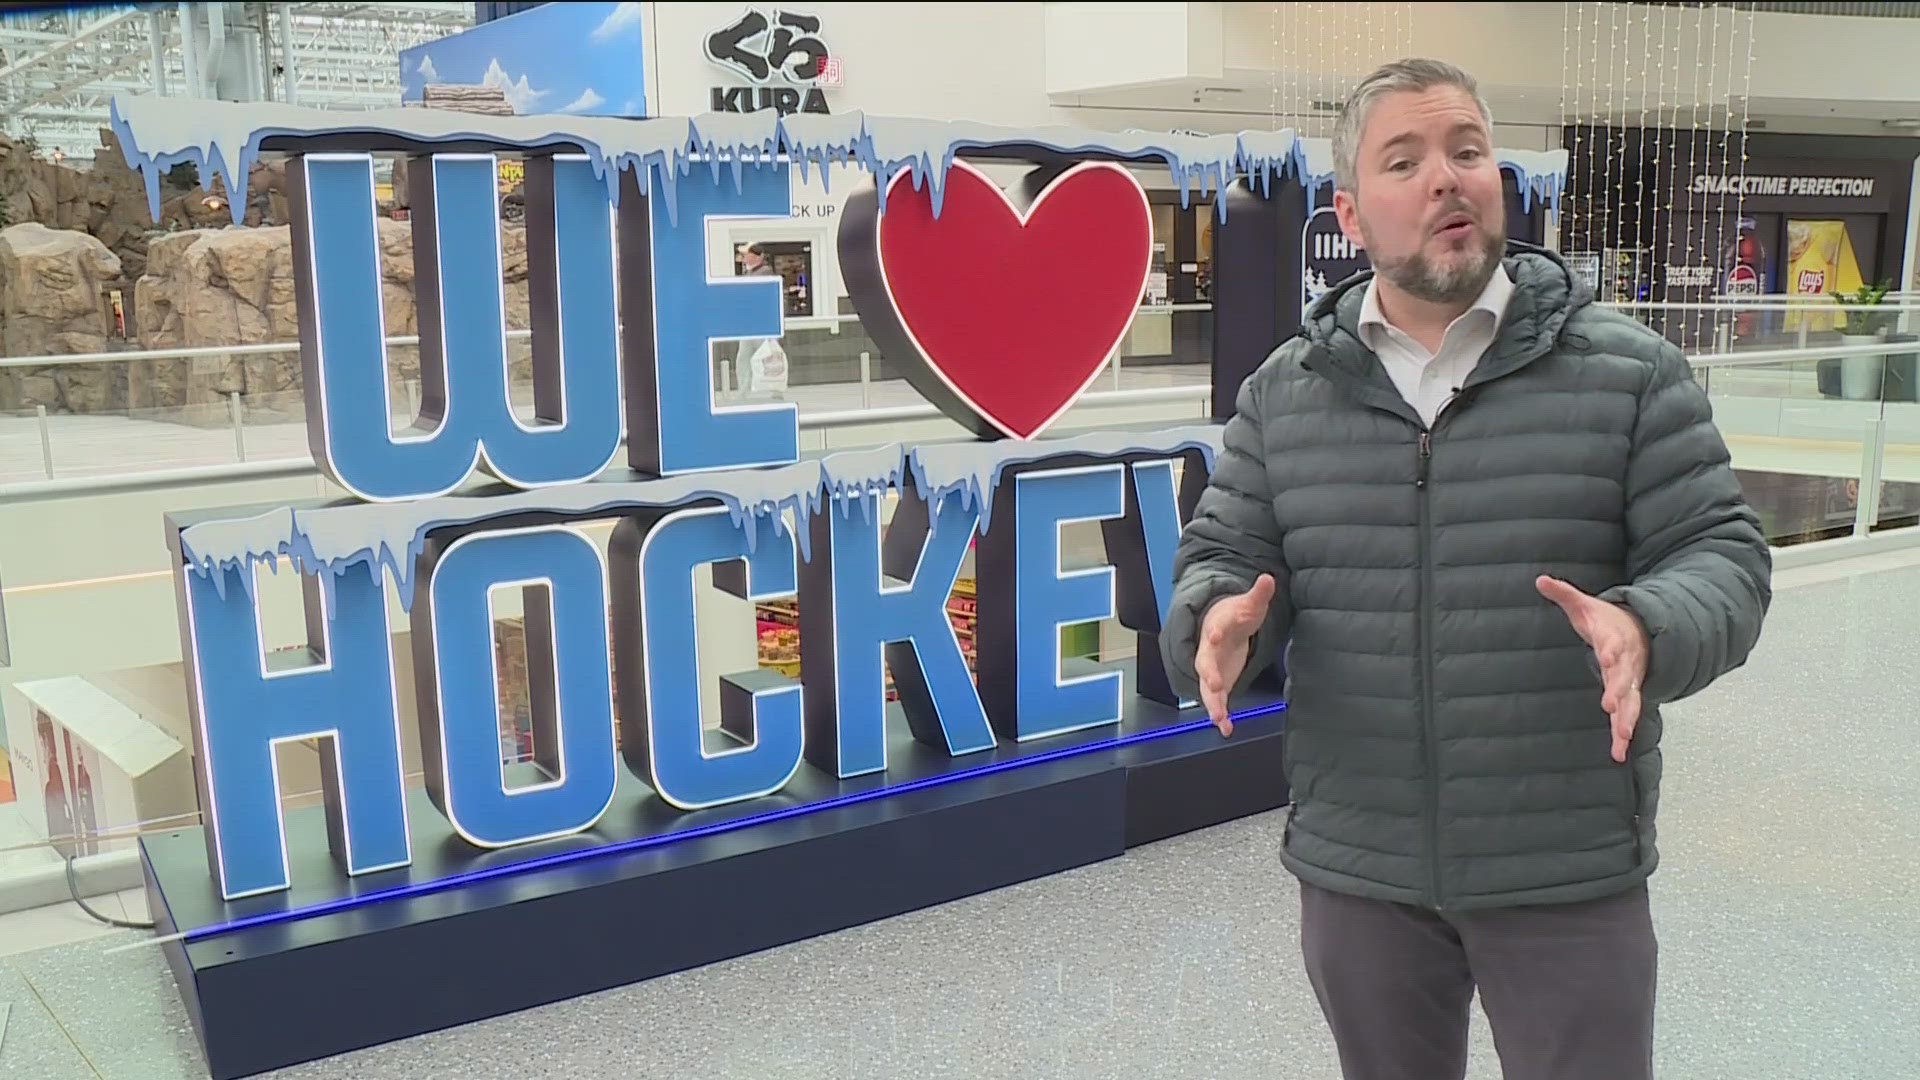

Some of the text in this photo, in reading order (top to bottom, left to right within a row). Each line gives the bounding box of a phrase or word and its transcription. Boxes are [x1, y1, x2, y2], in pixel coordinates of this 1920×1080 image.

[710, 87, 830, 116] KURA
[1693, 175, 1874, 196] SNACKTIME PERFECTION
[816, 204, 835, 217] UP
[1728, 283, 1755, 293] PEPSI
[303, 151, 800, 503] WE
